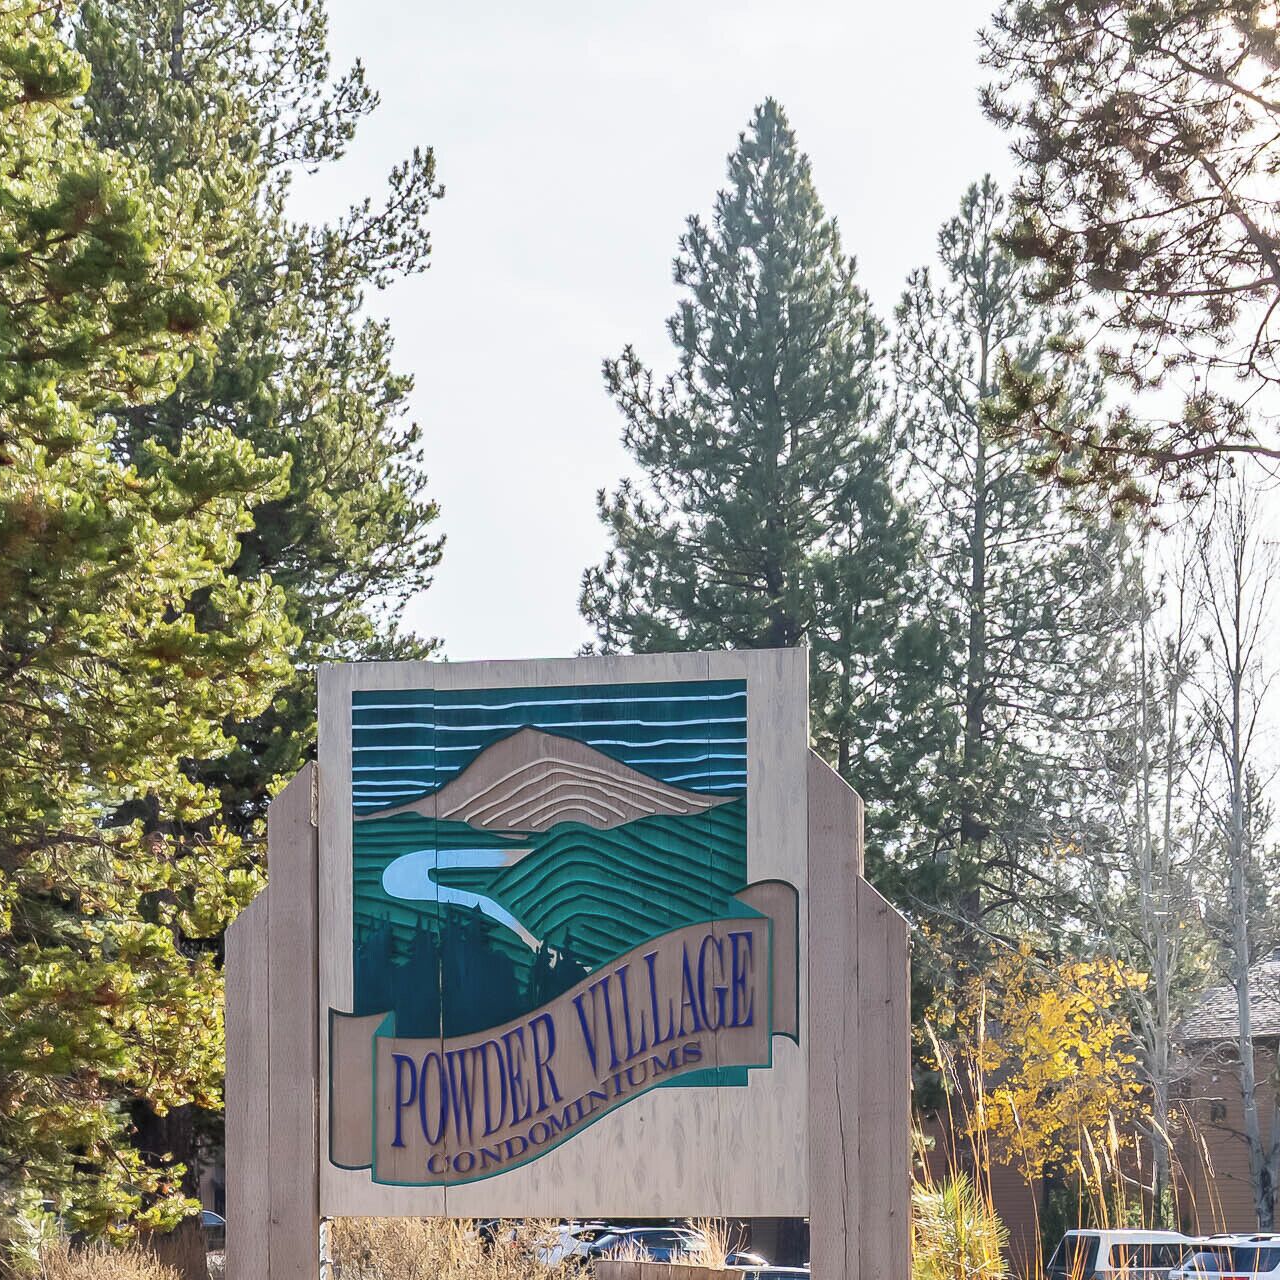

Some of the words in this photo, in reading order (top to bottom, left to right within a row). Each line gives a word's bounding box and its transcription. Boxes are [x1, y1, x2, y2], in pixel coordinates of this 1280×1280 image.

[390, 1012, 562, 1148] POWDER
[572, 931, 754, 1078] VILLAGE
[426, 1040, 704, 1175] CONDOMINIUMS
